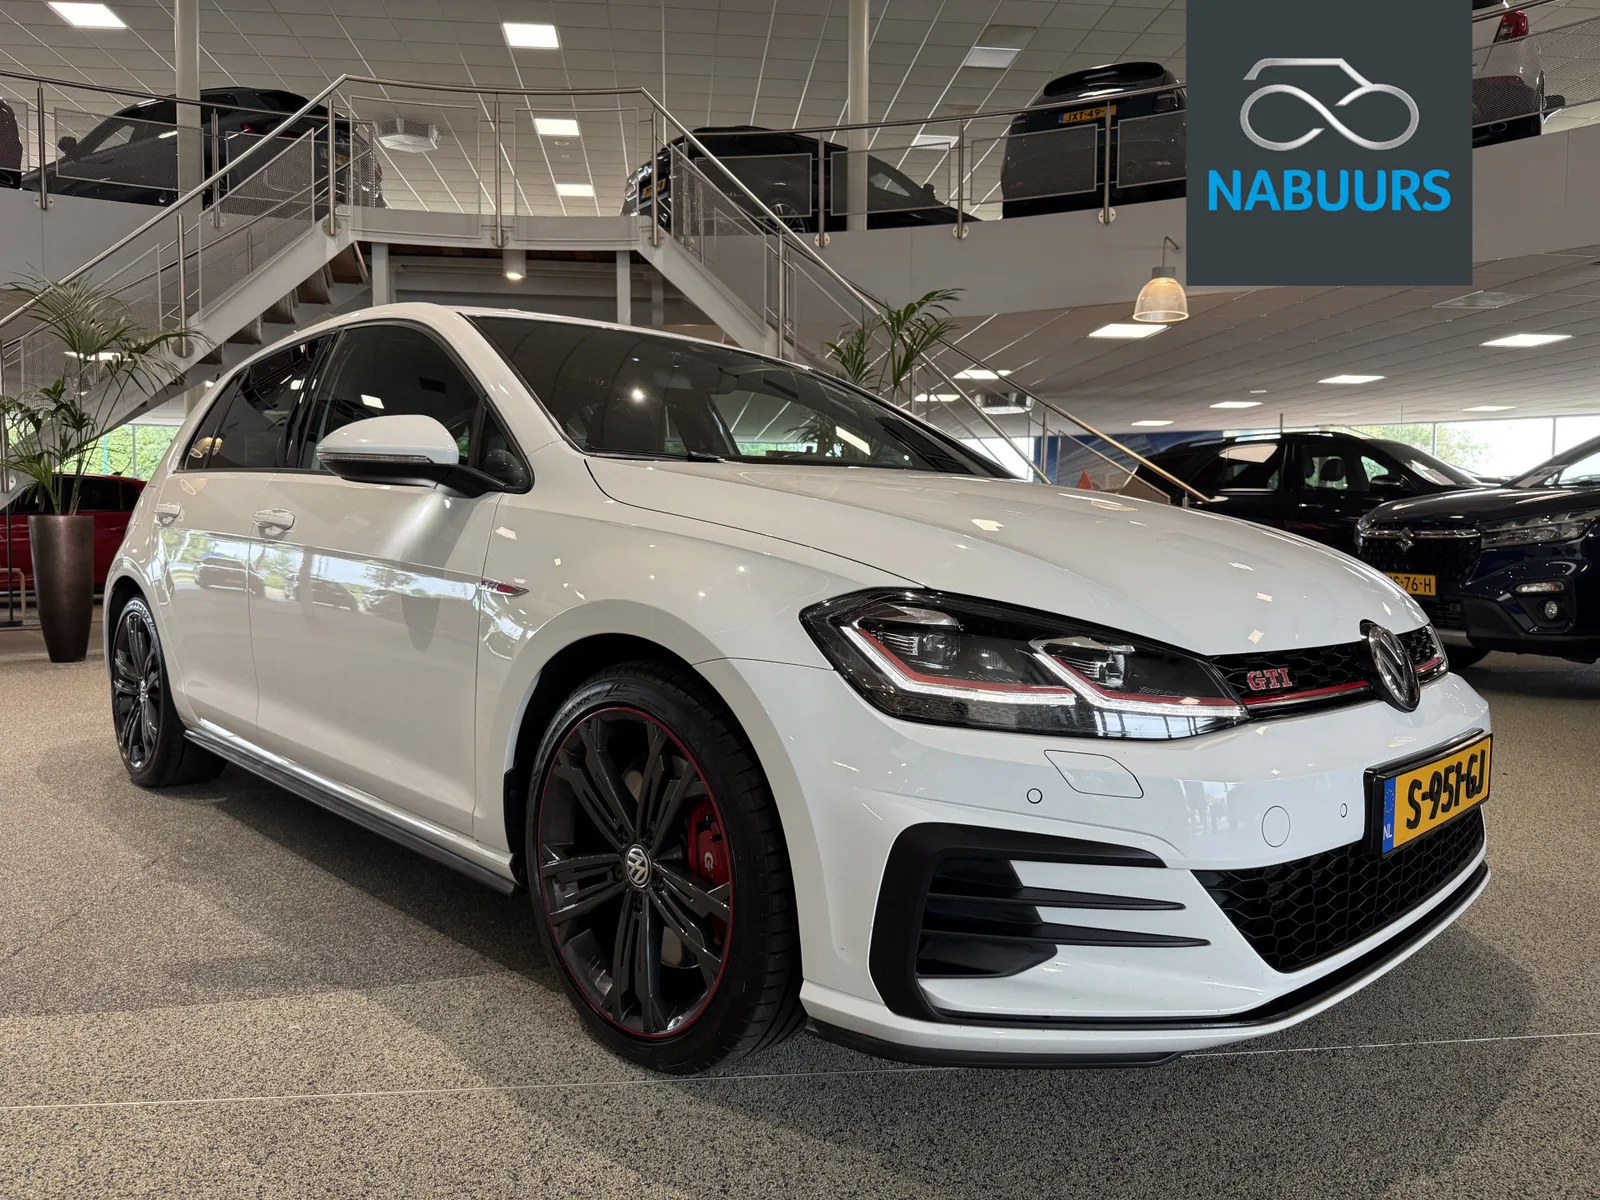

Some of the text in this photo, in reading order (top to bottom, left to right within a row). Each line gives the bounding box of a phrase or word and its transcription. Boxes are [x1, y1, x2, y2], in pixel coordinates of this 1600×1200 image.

[1066, 106, 1111, 121] JXT-49-
[1247, 668, 1292, 690] GTI
[1406, 749, 1486, 829] S-951-GJ
[1383, 823, 1393, 839] NL
